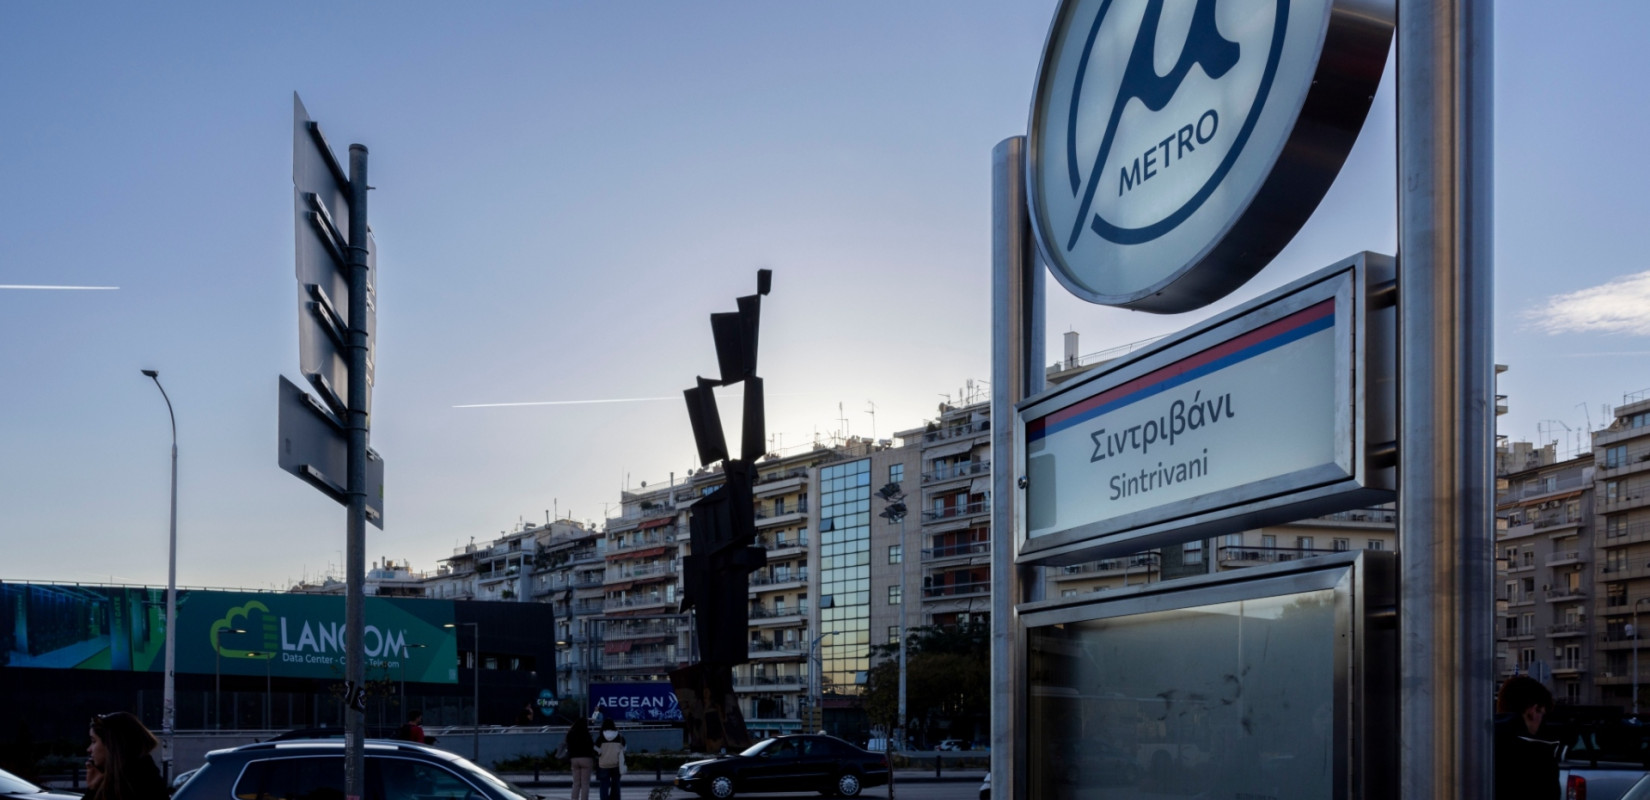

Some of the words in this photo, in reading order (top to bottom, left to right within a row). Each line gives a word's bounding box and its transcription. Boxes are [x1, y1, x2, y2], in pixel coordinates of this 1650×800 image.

[1118, 109, 1220, 197] METRO
[1090, 389, 1235, 463] Σιντριβάνι
[1109, 448, 1208, 501] Sintrivani
[282, 652, 303, 663] Data
[305, 654, 333, 665] Center
[369, 658, 400, 668] Teleom
[597, 696, 664, 707] AEGEAN
